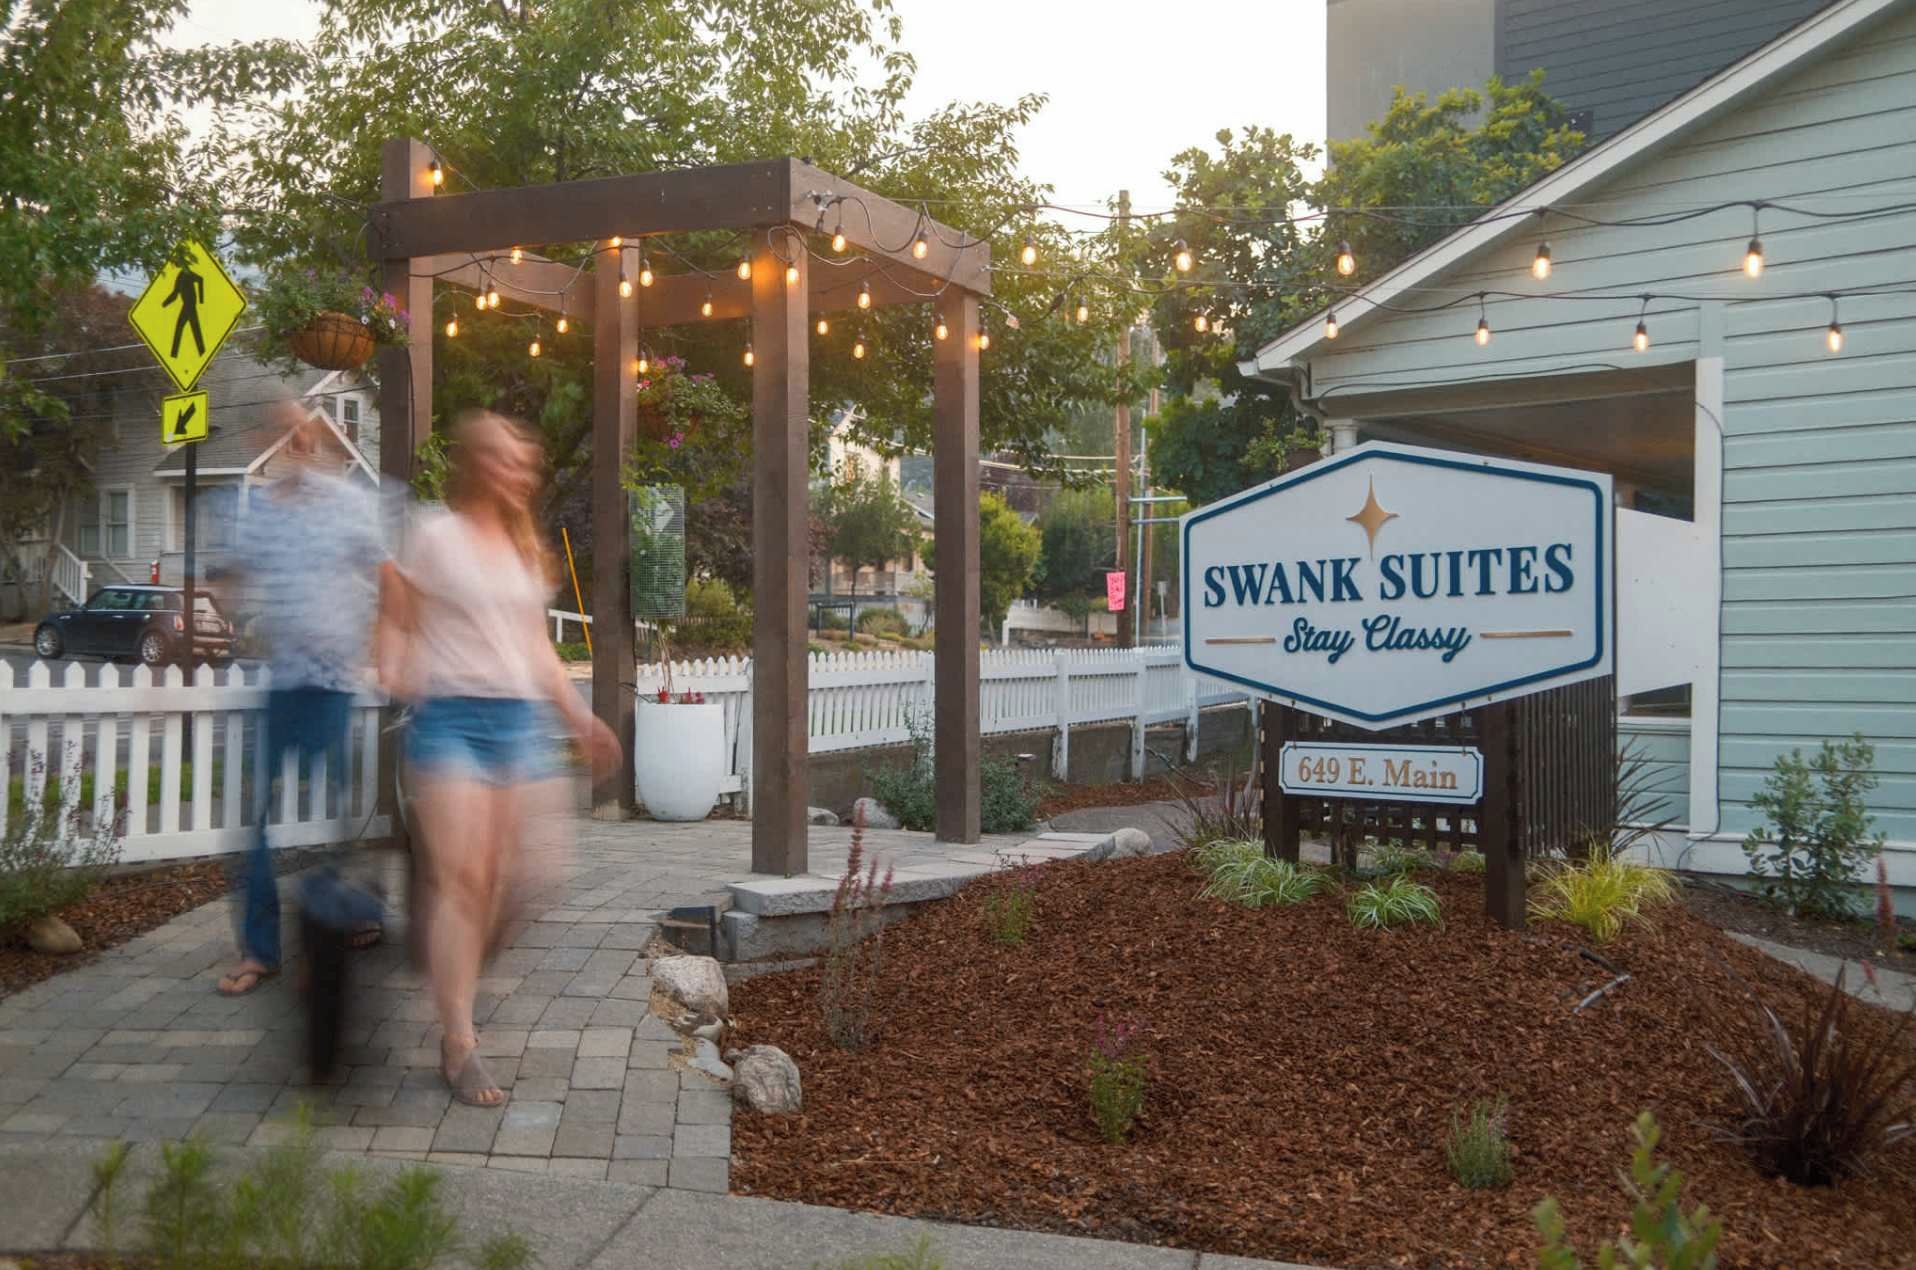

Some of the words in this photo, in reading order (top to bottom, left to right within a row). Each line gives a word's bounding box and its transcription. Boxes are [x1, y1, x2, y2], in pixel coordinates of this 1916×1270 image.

[1204, 557, 1363, 608] SWANK
[1380, 543, 1574, 600] SUITES
[1283, 617, 1355, 664] Stay
[1361, 615, 1472, 664] Classy
[1297, 755, 1341, 785] 649
[1347, 756, 1374, 787] E.
[1382, 759, 1458, 790] Main
